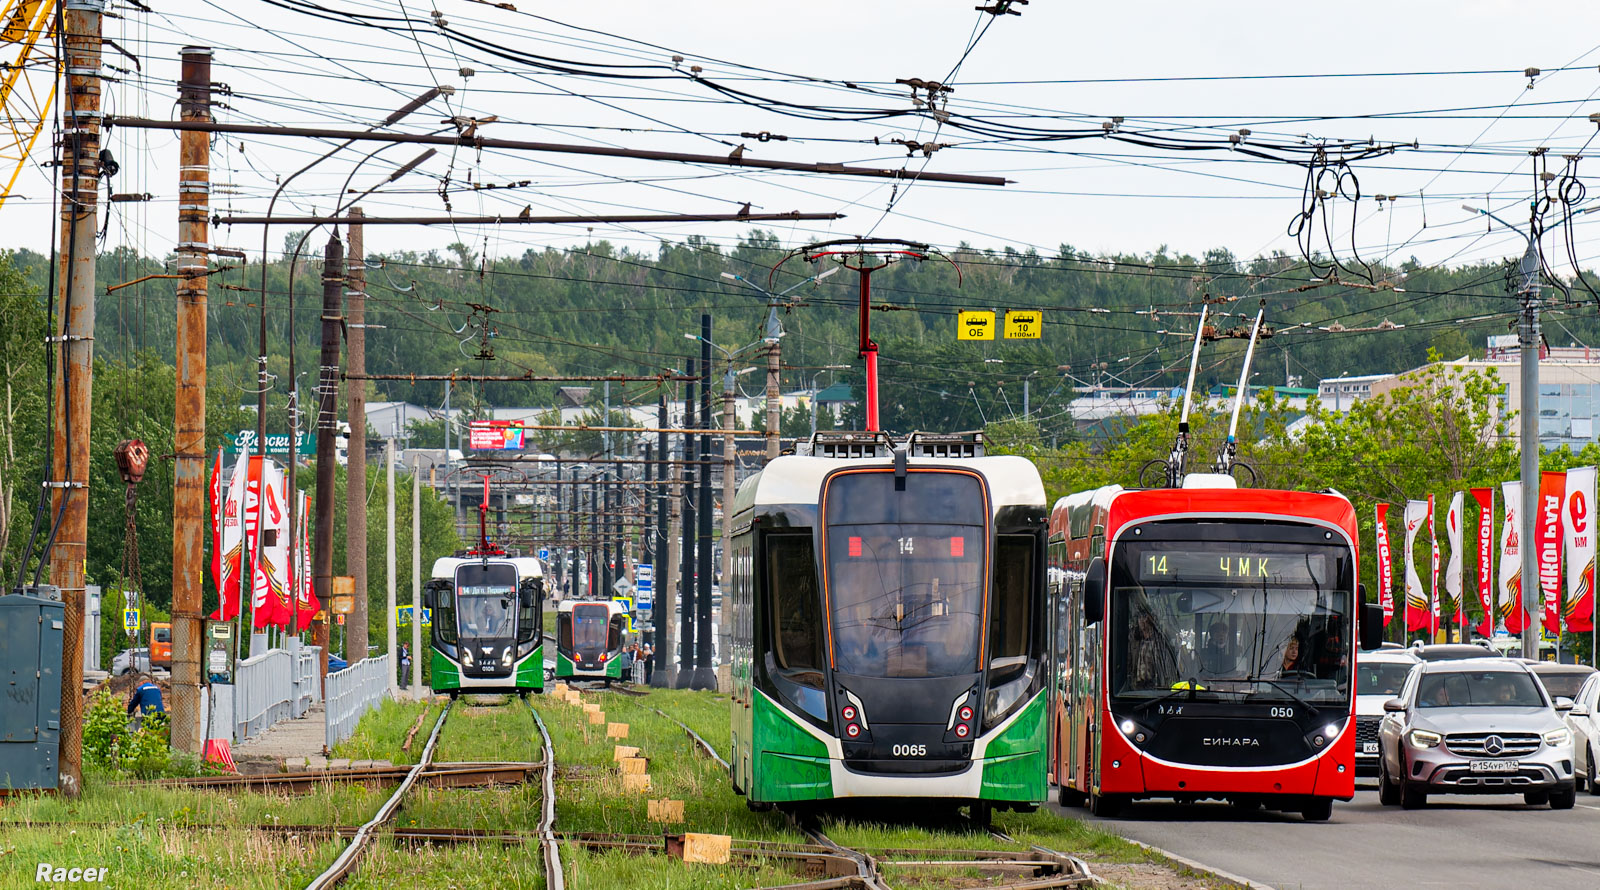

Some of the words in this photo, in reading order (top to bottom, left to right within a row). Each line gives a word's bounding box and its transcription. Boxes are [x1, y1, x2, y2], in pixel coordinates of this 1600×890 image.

[969, 329, 983, 337] ОБ
[1017, 324, 1029, 332] 10
[897, 538, 914, 555] 14
[1149, 555, 1168, 575] 14
[1270, 707, 1293, 718] 050
[1203, 738, 1260, 747] СИНАРА
[892, 744, 926, 756] 0065
